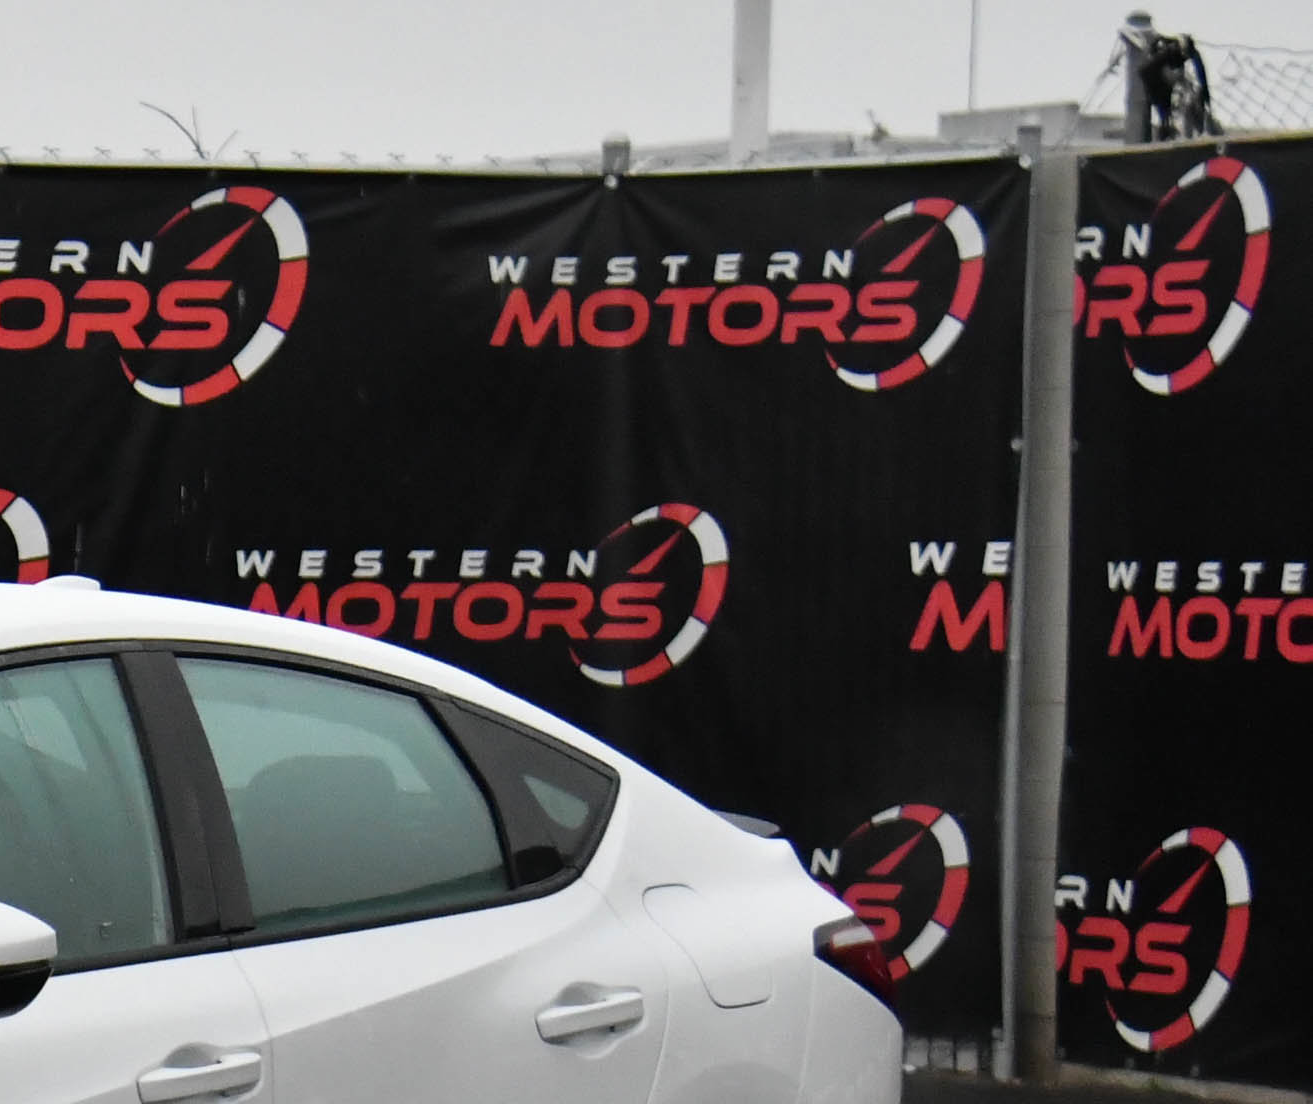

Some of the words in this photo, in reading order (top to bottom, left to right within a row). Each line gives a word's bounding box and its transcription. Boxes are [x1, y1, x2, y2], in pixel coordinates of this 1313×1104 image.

[489, 250, 852, 284] WESTERN
[491, 281, 918, 347] MOTORS
[1074, 261, 1209, 337] RS
[237, 551, 596, 577] WESTERN
[1108, 562, 1305, 592] WESTE
[1055, 918, 1190, 993] RS
